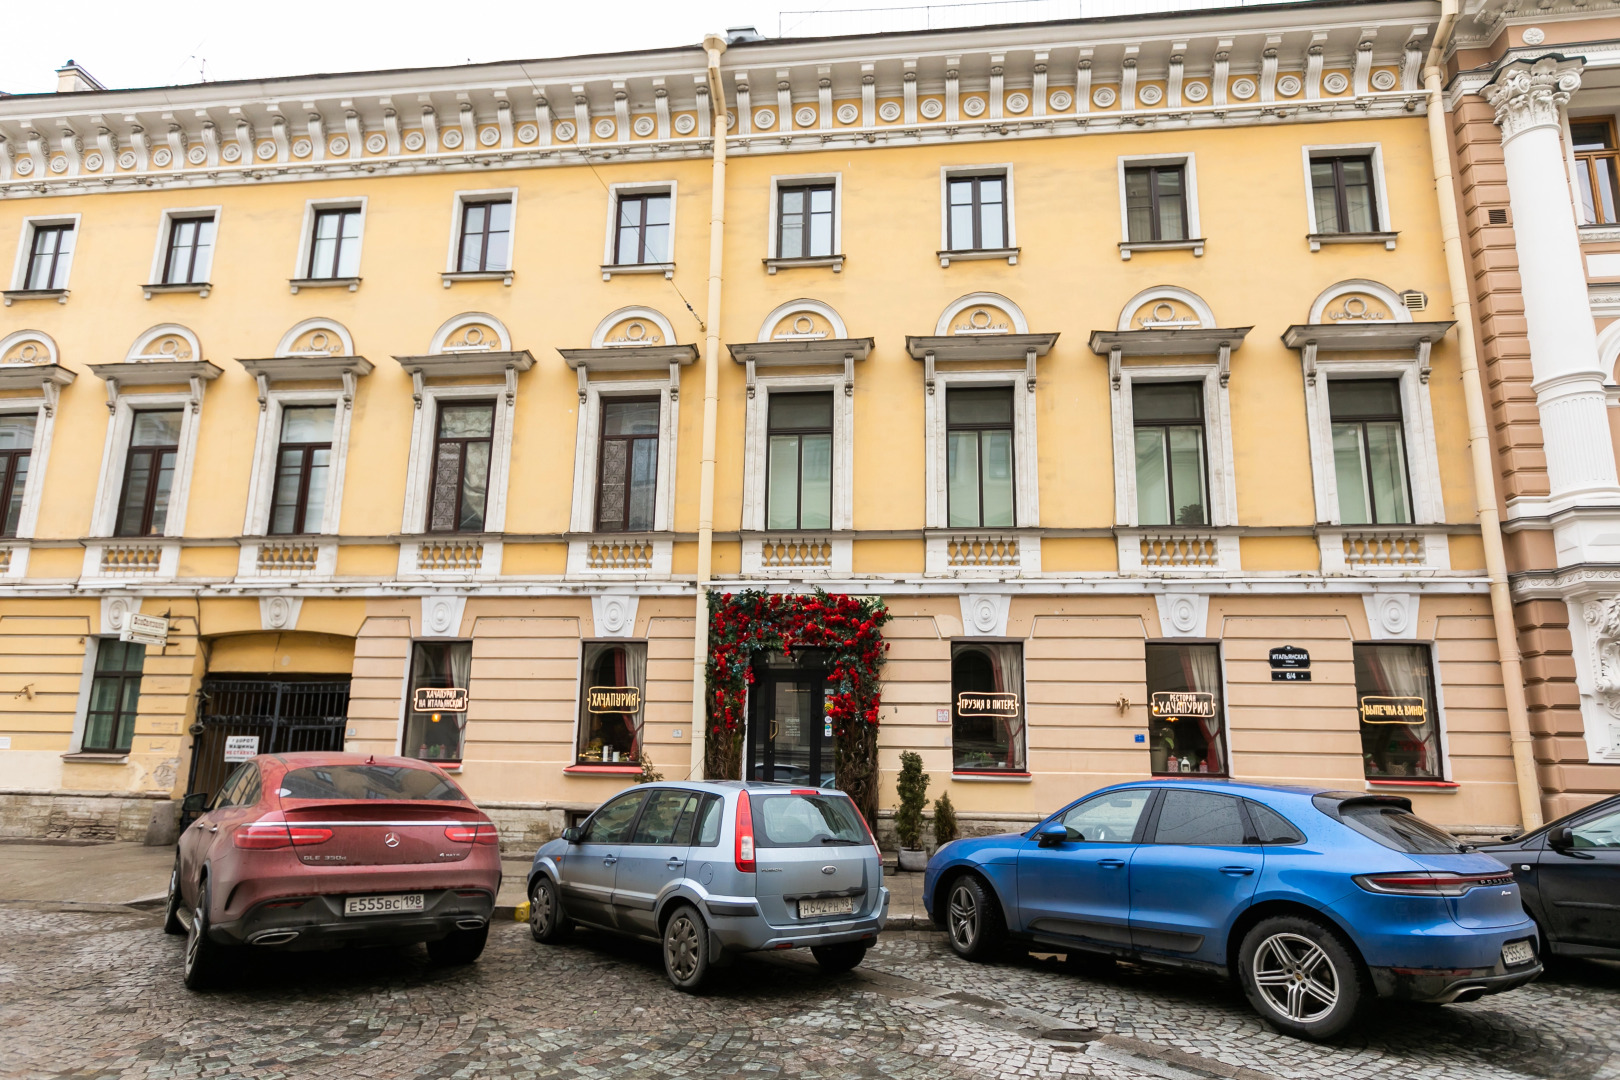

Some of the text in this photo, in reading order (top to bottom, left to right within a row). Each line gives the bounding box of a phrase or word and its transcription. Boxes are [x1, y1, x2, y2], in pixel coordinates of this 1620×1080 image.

[426, 690, 457, 699] ХАЧАПУРИЯ
[591, 692, 637, 707] ХАЧАПУРИЯ
[1169, 694, 1197, 702] РЕСТОРАН
[418, 698, 426, 708] НА
[961, 698, 1015, 710] ГРУЗИЯ В ПИТЕРЕ
[1158, 701, 1209, 716] ХАЧАПУРИЯ
[1364, 704, 1423, 716] ВЫПЕЧКА & ВИНО
[403, 895, 422, 905] 198
